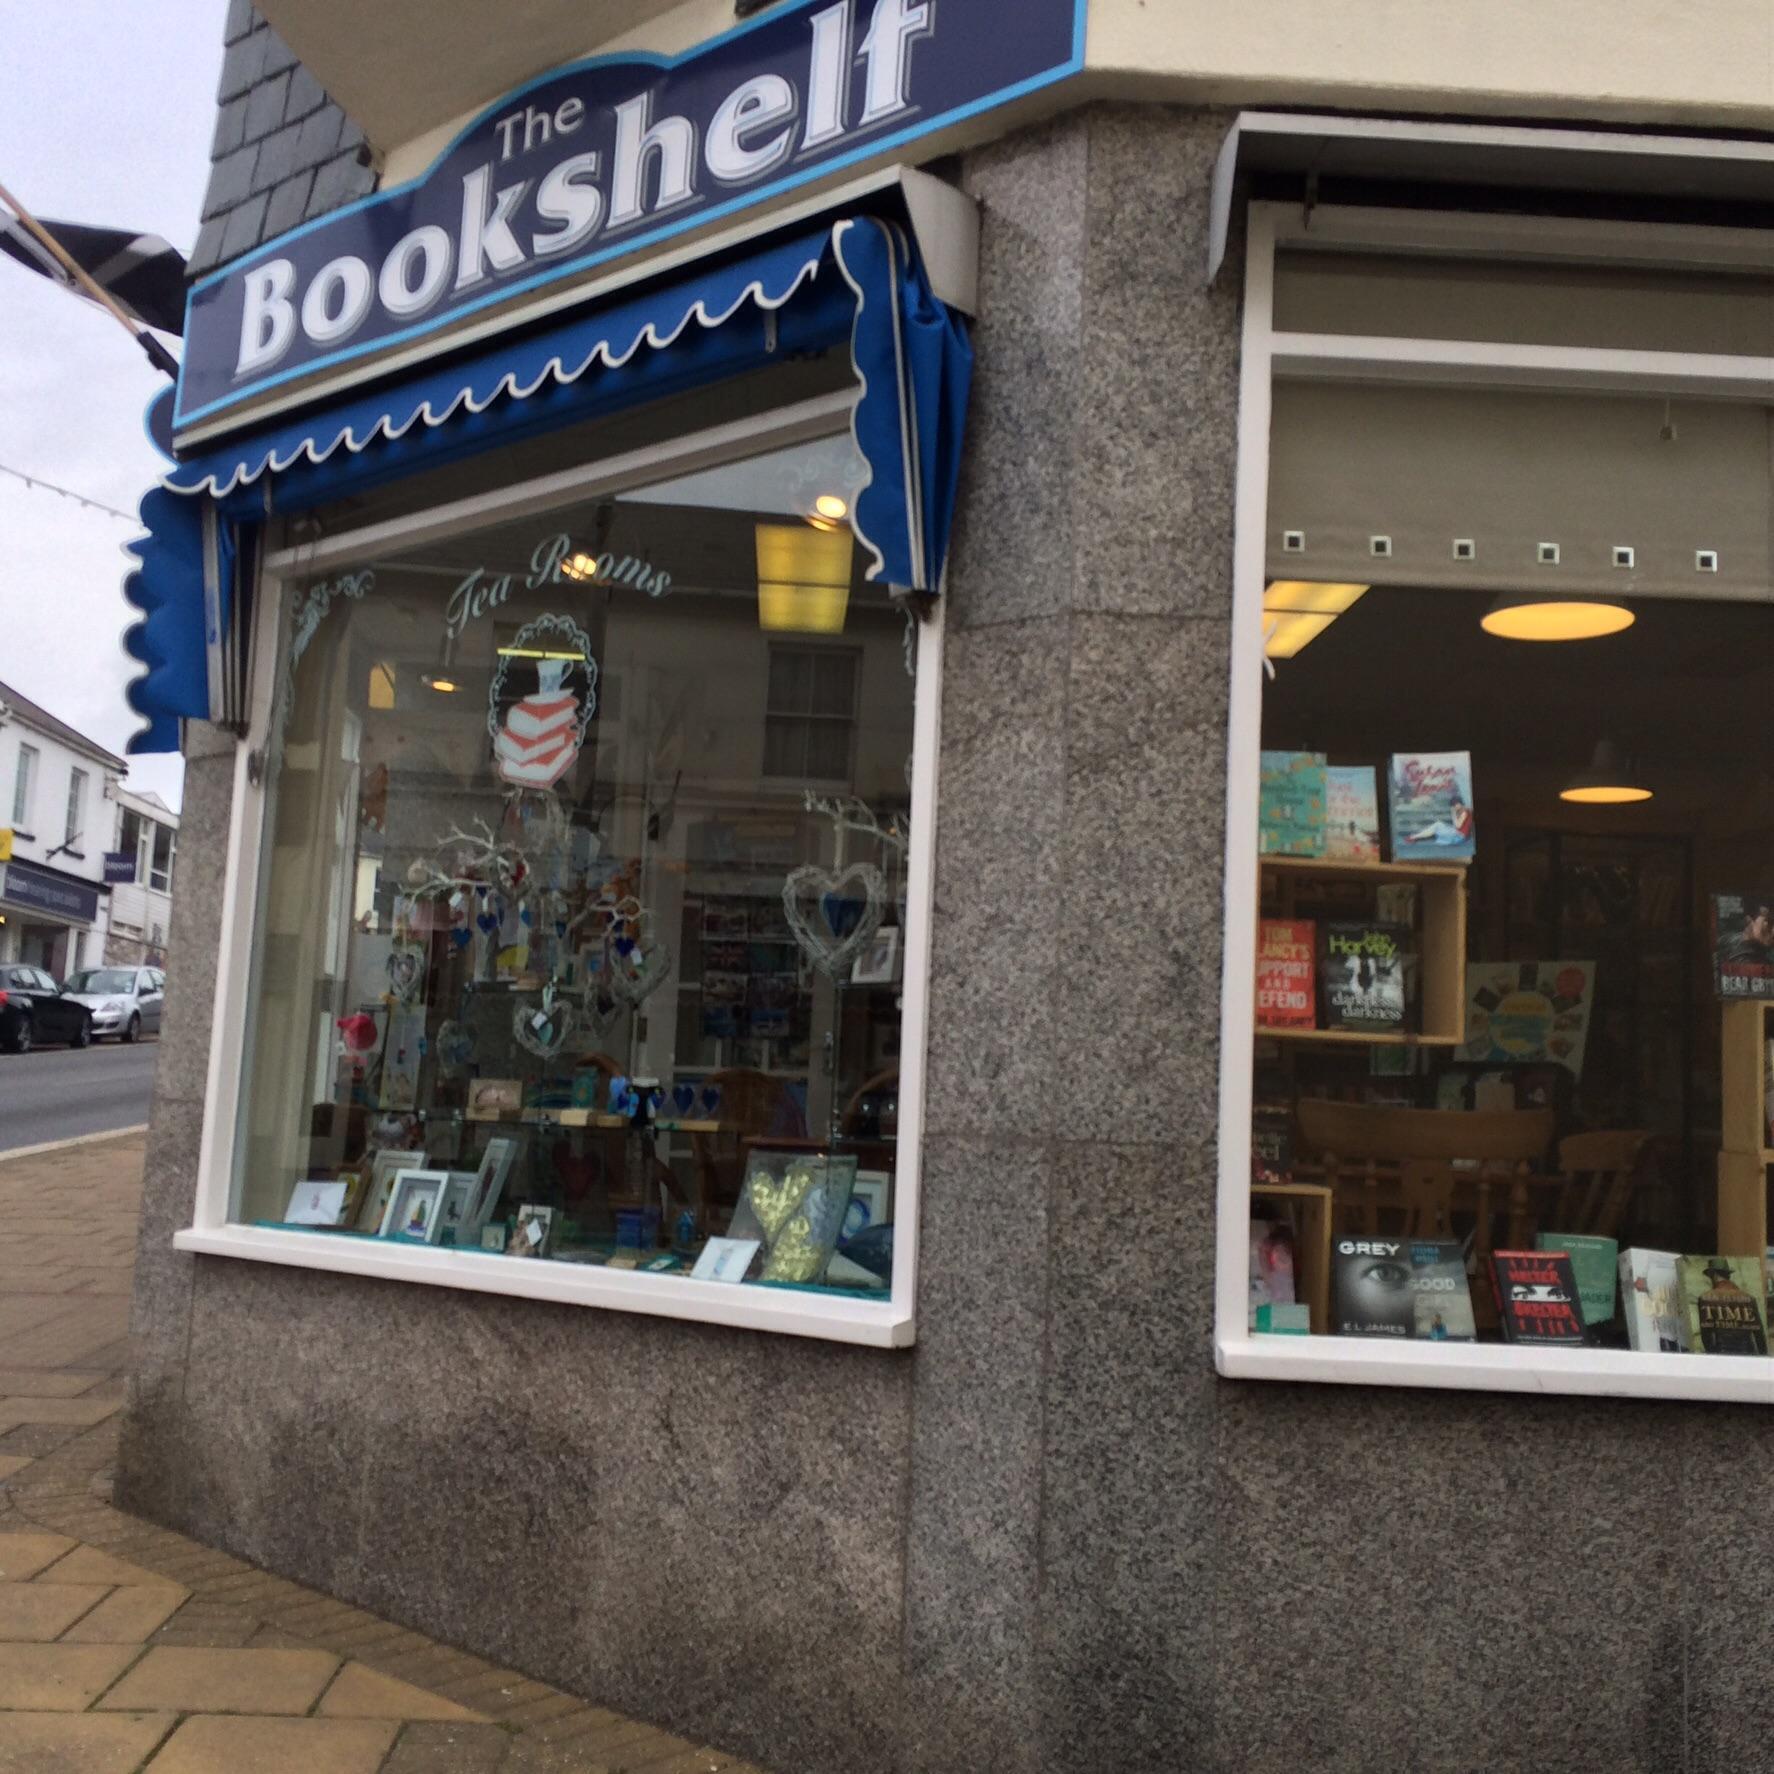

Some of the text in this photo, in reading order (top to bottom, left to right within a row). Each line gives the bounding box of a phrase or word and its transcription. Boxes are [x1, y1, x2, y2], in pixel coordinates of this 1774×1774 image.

[496, 96, 584, 161] The
[231, 0, 937, 381] Bookshelf
[446, 532, 672, 639] Tea Roms
[1258, 990, 1307, 1010] EFEND
[1338, 1240, 1400, 1256] GREY
[1701, 1304, 1756, 1322] TIME
[1364, 1323, 1407, 1335] JAMES
